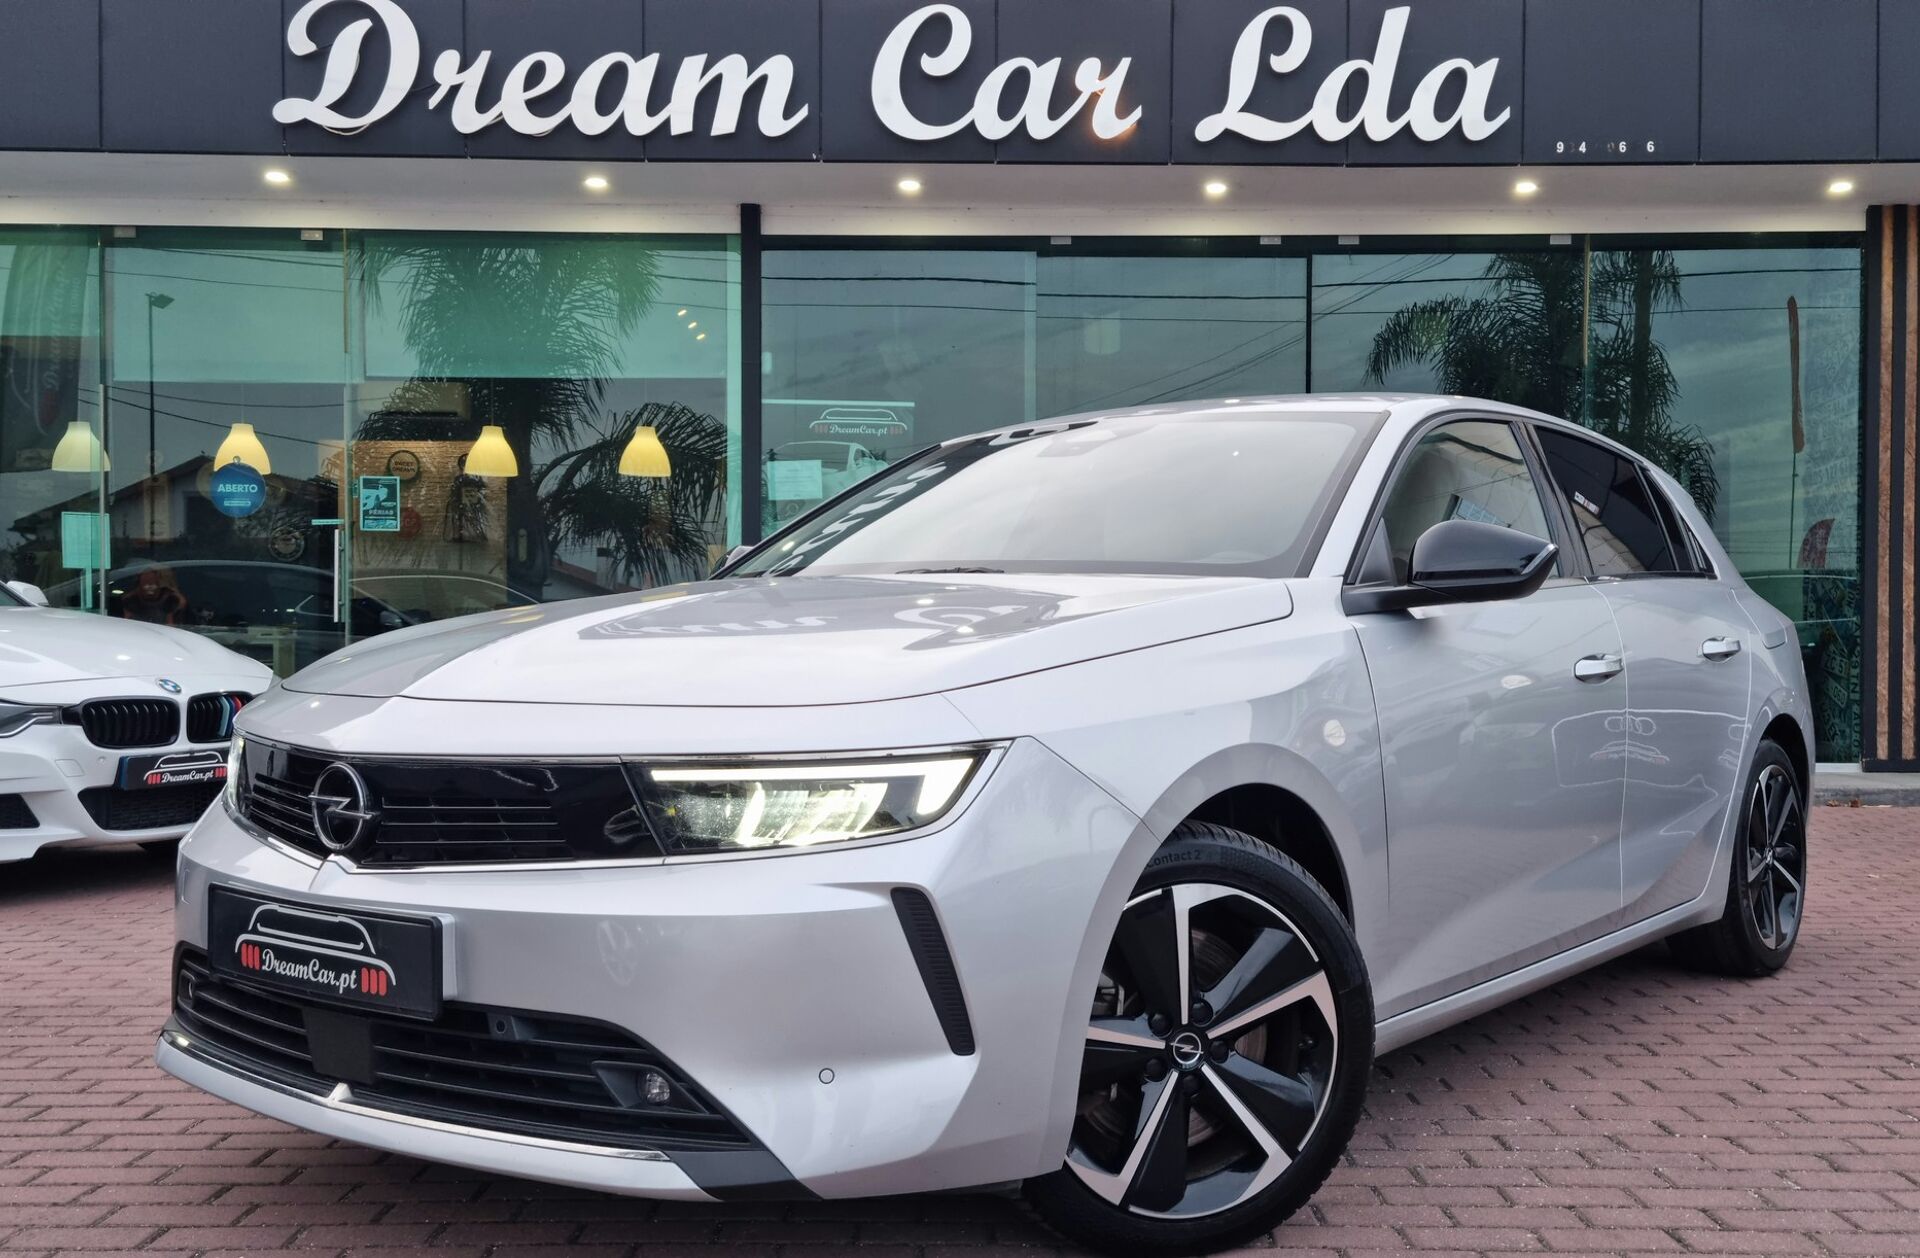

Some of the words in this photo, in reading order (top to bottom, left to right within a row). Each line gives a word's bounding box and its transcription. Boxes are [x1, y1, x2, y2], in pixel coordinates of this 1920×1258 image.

[273, 0, 808, 136] Dream
[872, 4, 1142, 141] Car
[1195, 6, 1511, 142] Lda
[829, 424, 888, 436] DreamCar.pt
[217, 484, 258, 492] ABERTO
[161, 770, 214, 782] DreamCar.pt
[262, 949, 358, 994] DreamCar.pt
